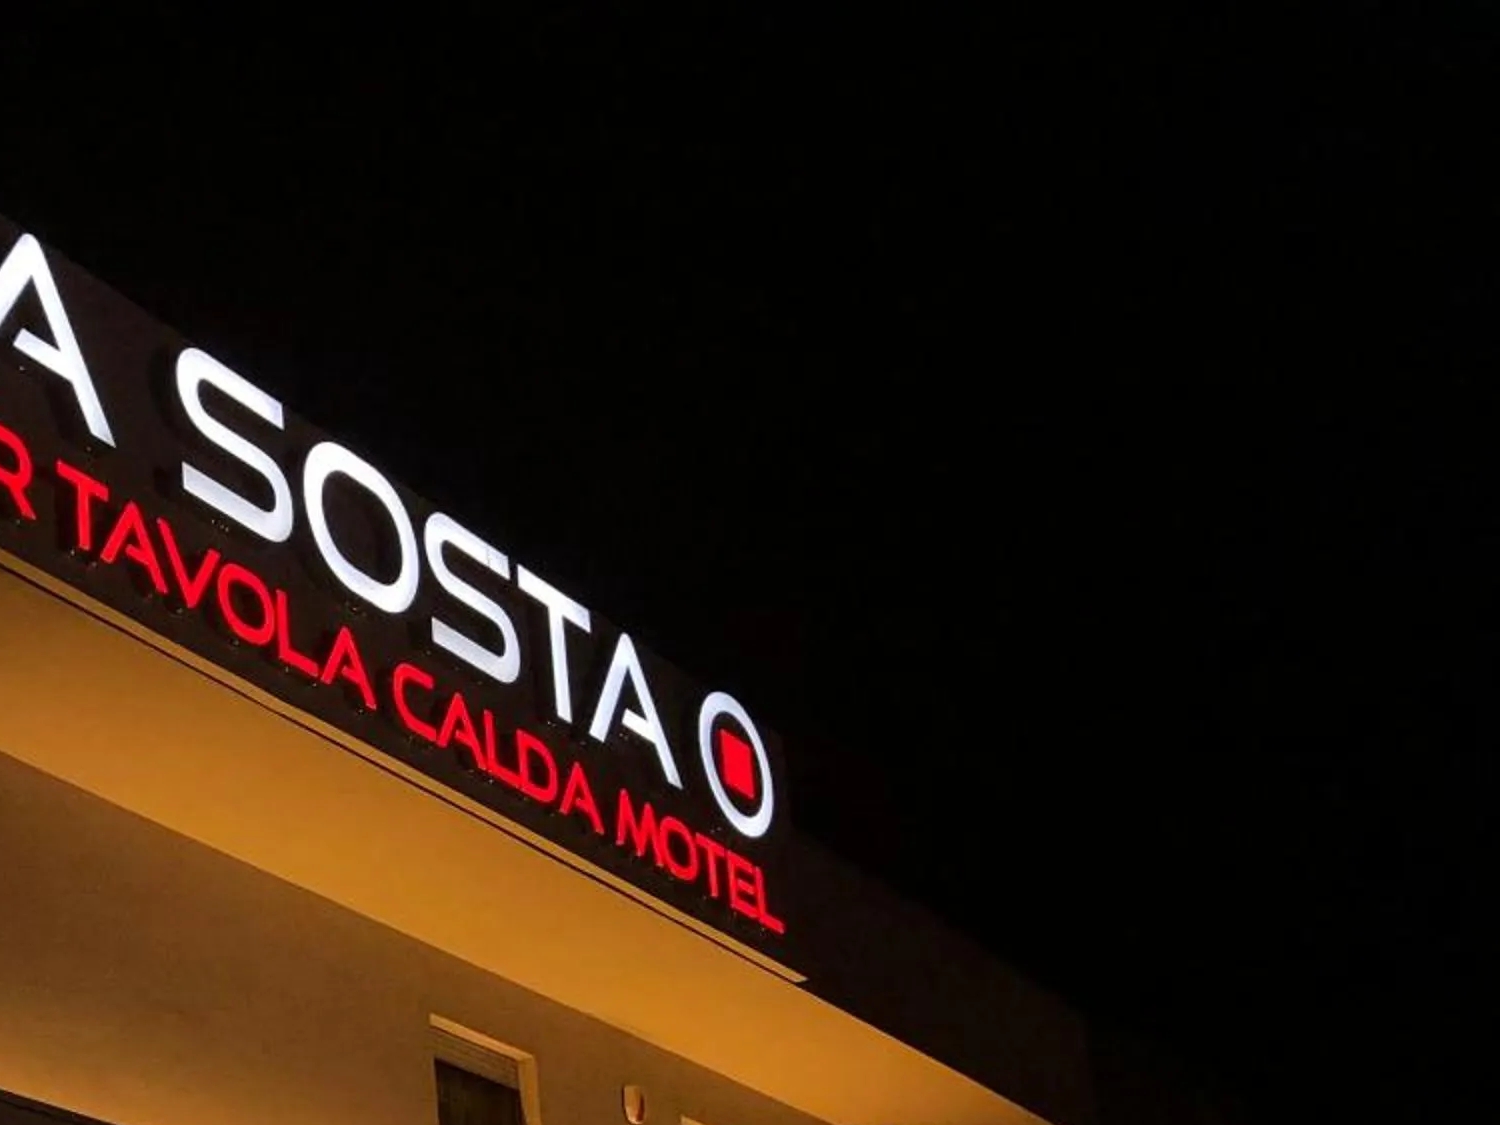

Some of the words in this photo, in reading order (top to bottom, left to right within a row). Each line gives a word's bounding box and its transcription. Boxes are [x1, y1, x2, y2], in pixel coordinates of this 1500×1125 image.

[57, 461, 376, 709] TAVOLA
[393, 662, 603, 833] CALDA
[616, 787, 784, 932] MOTEL
[176, 347, 682, 789] SOSTA
